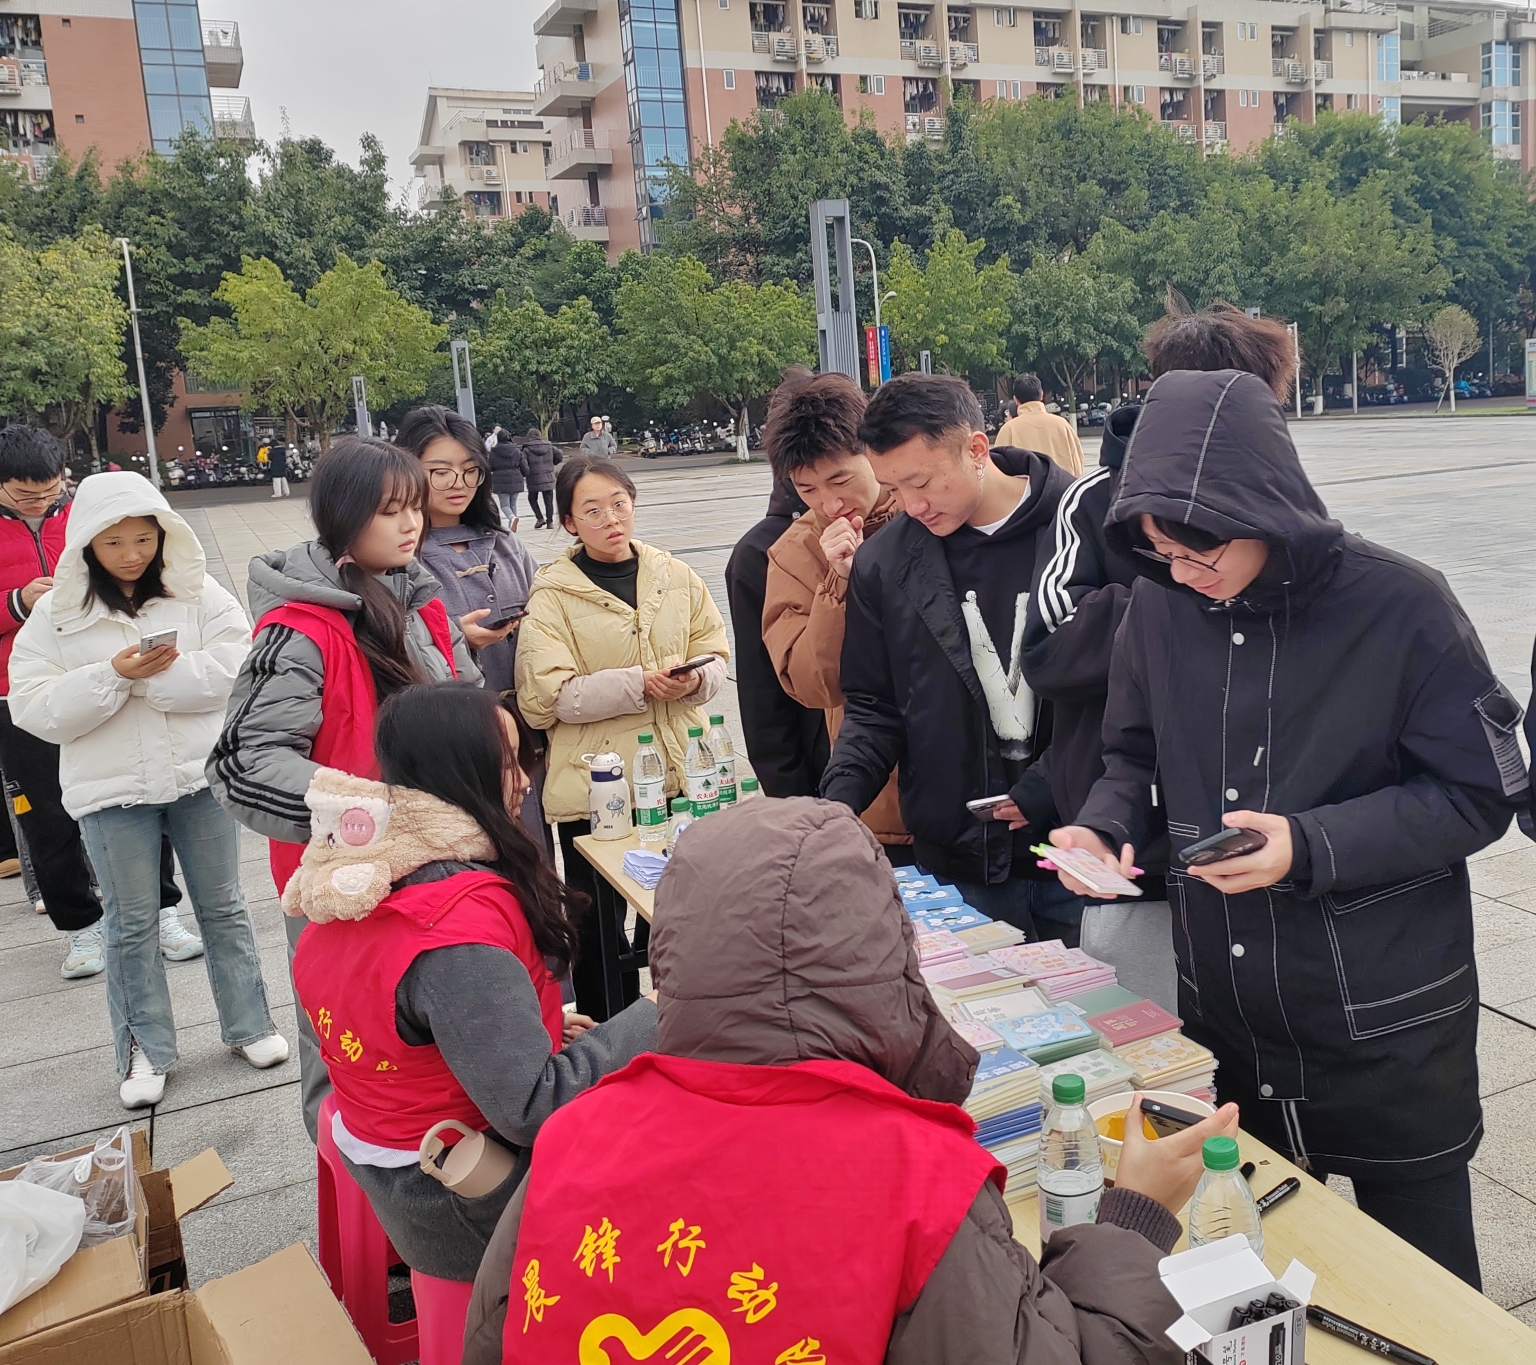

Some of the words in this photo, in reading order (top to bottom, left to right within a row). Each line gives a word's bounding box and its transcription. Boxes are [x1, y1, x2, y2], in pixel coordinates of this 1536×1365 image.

[1321, 1319, 1336, 1332] Marker
[1336, 1326, 1359, 1342] Permanent
[1359, 1332, 1391, 1356] 记号笔
